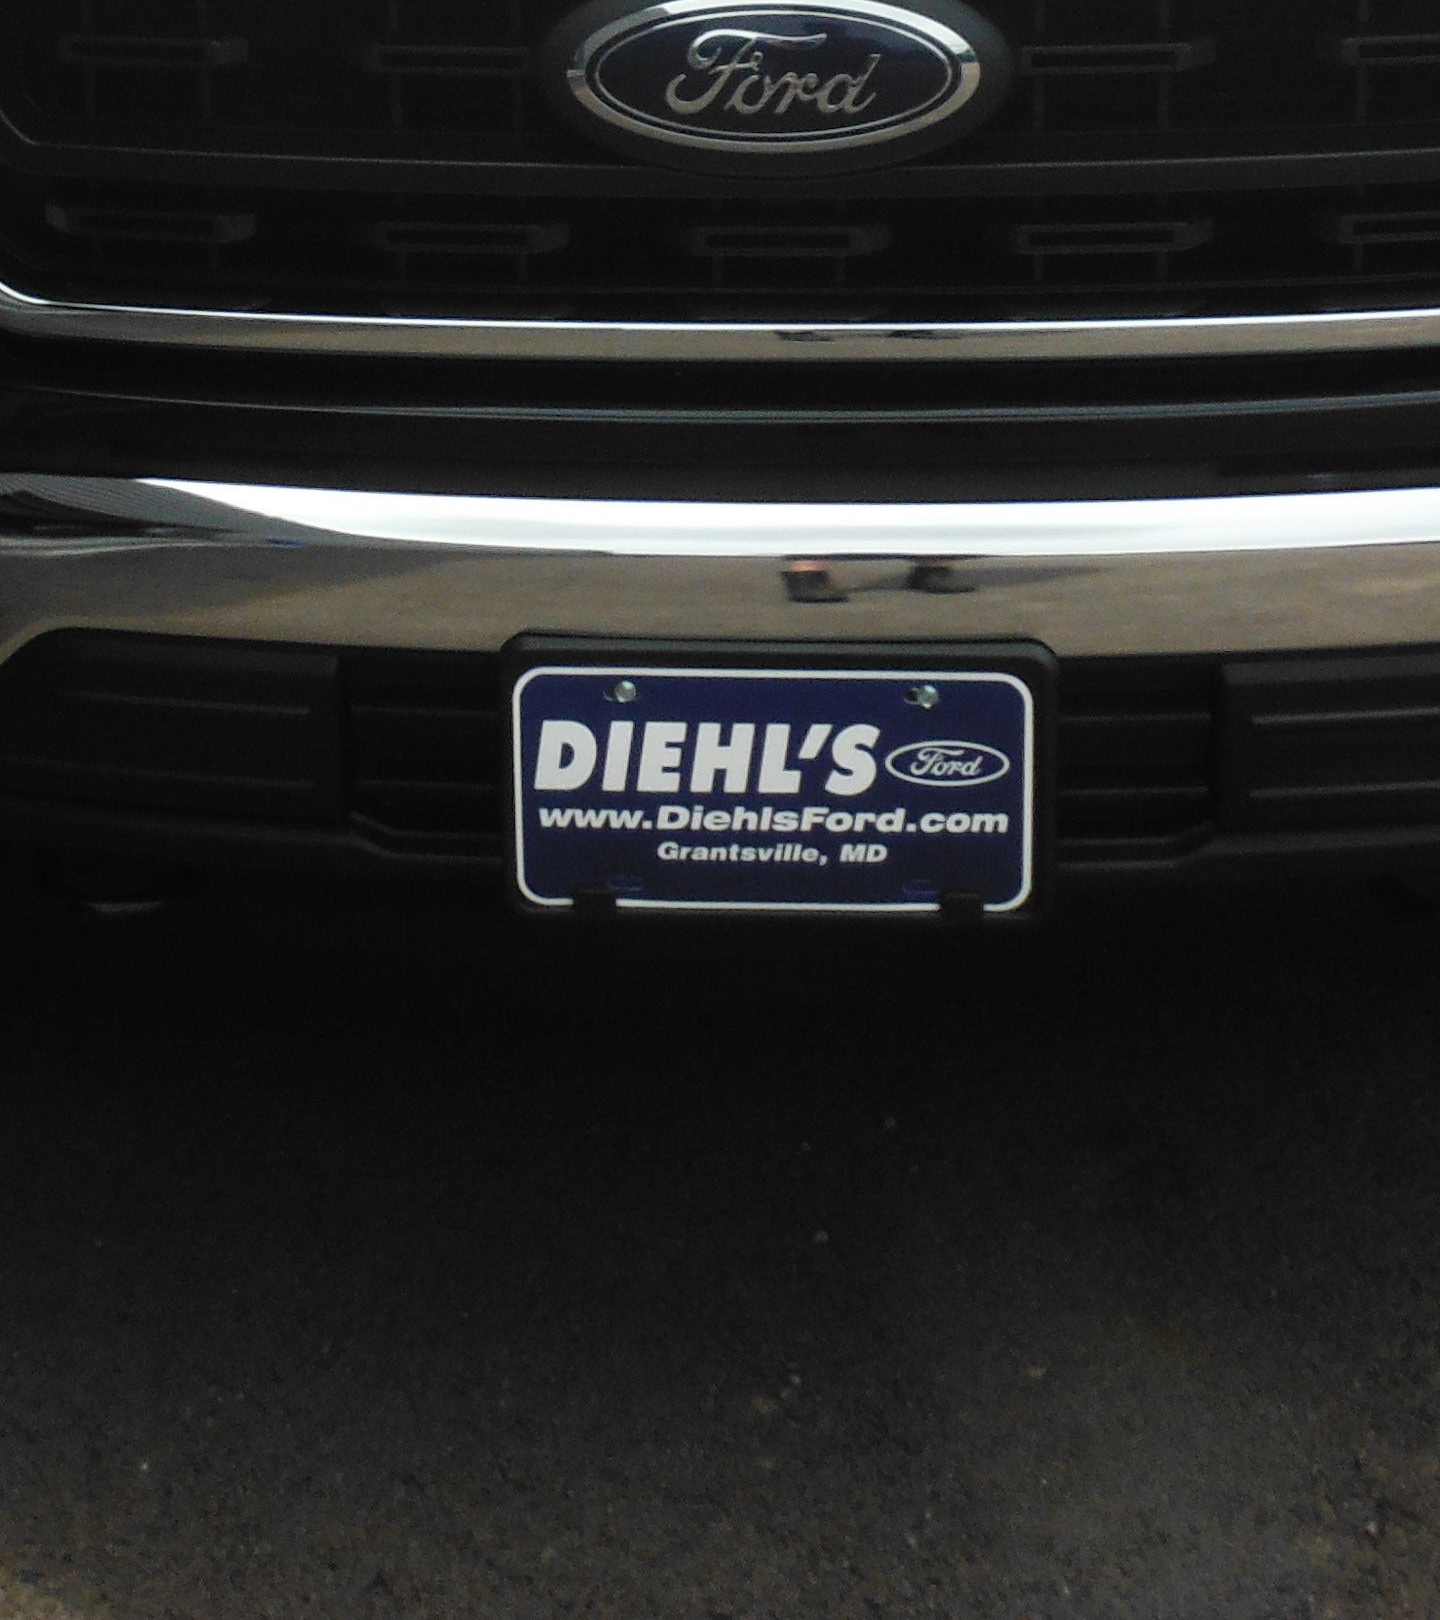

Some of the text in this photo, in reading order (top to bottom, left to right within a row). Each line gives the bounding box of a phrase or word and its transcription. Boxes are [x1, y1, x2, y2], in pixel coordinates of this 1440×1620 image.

[665, 27, 881, 116] Ford
[534, 718, 882, 797] DIEHL'S
[907, 746, 985, 779] Ford
[538, 804, 1010, 834] www.DiehlsFord.com
[656, 840, 889, 867] Grantsville, MD
